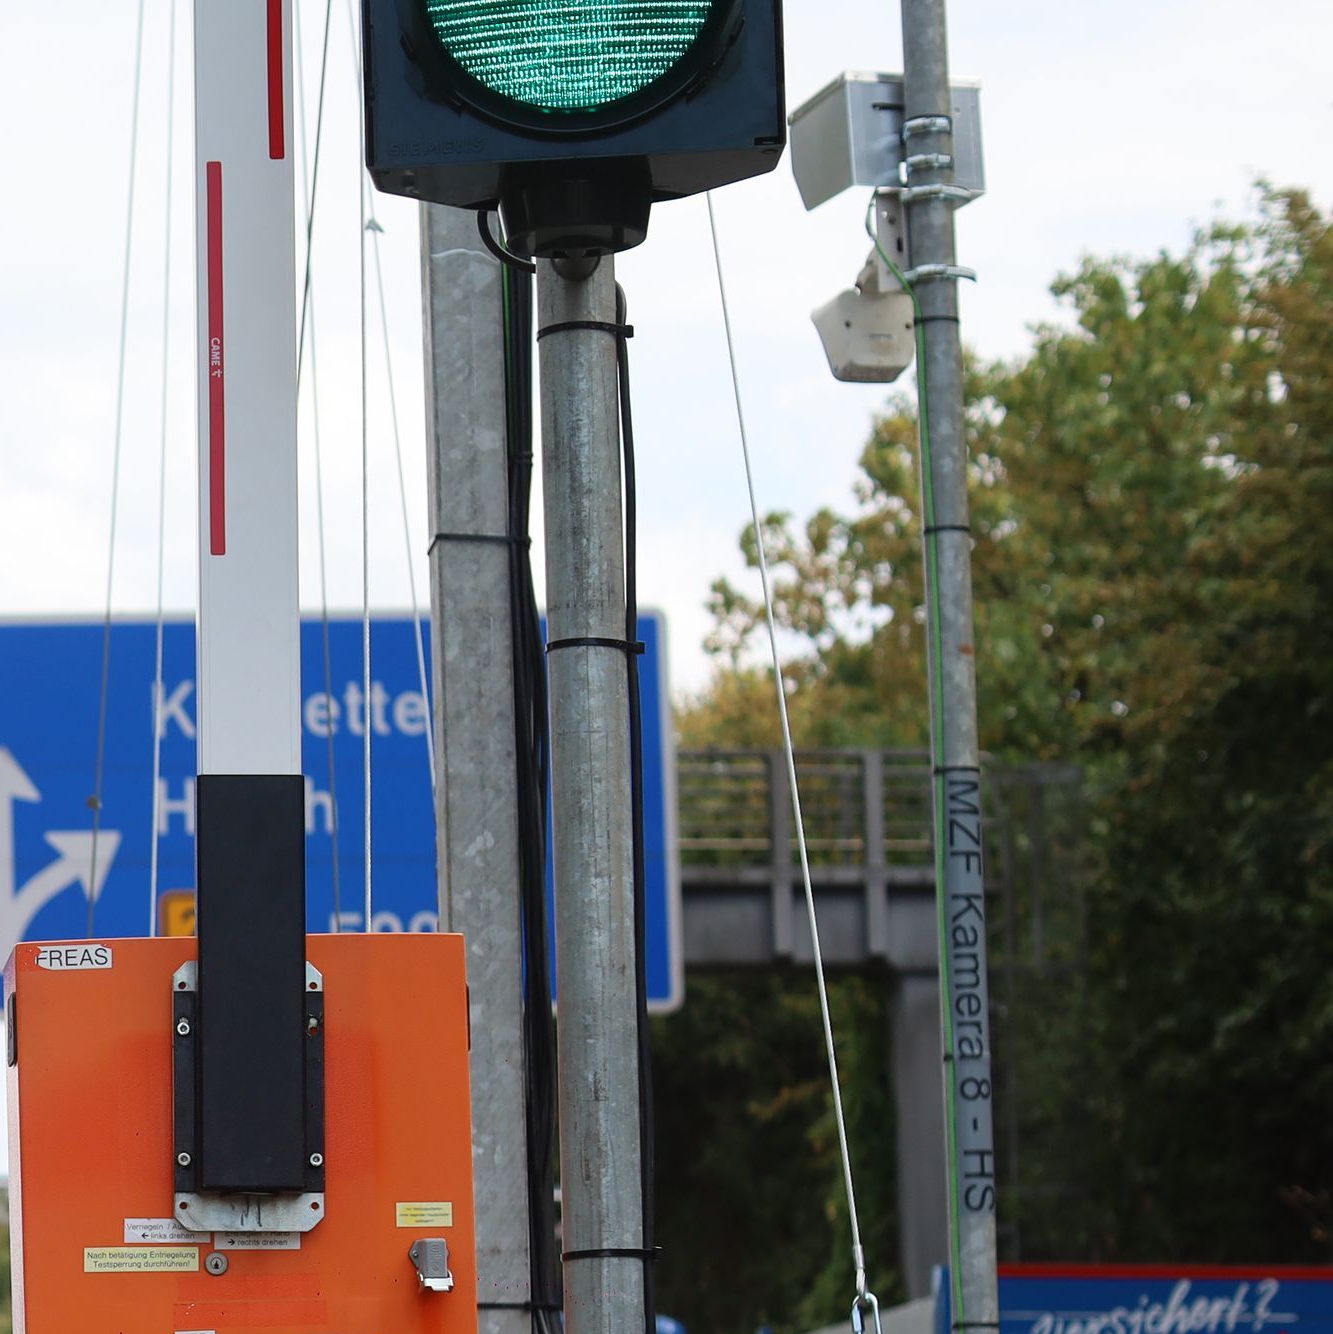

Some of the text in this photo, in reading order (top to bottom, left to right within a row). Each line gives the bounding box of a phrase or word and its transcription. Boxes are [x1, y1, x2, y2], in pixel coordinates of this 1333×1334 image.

[211, 337, 221, 366] CAME
[943, 780, 983, 876] MZF
[951, 893, 989, 1062] Kamera
[959, 1077, 991, 1101] 8
[963, 1149, 995, 1212] HS
[94, 1260, 191, 1269] Testsperrung durchführen!
[150, 1252, 196, 1260] Entriegelung
